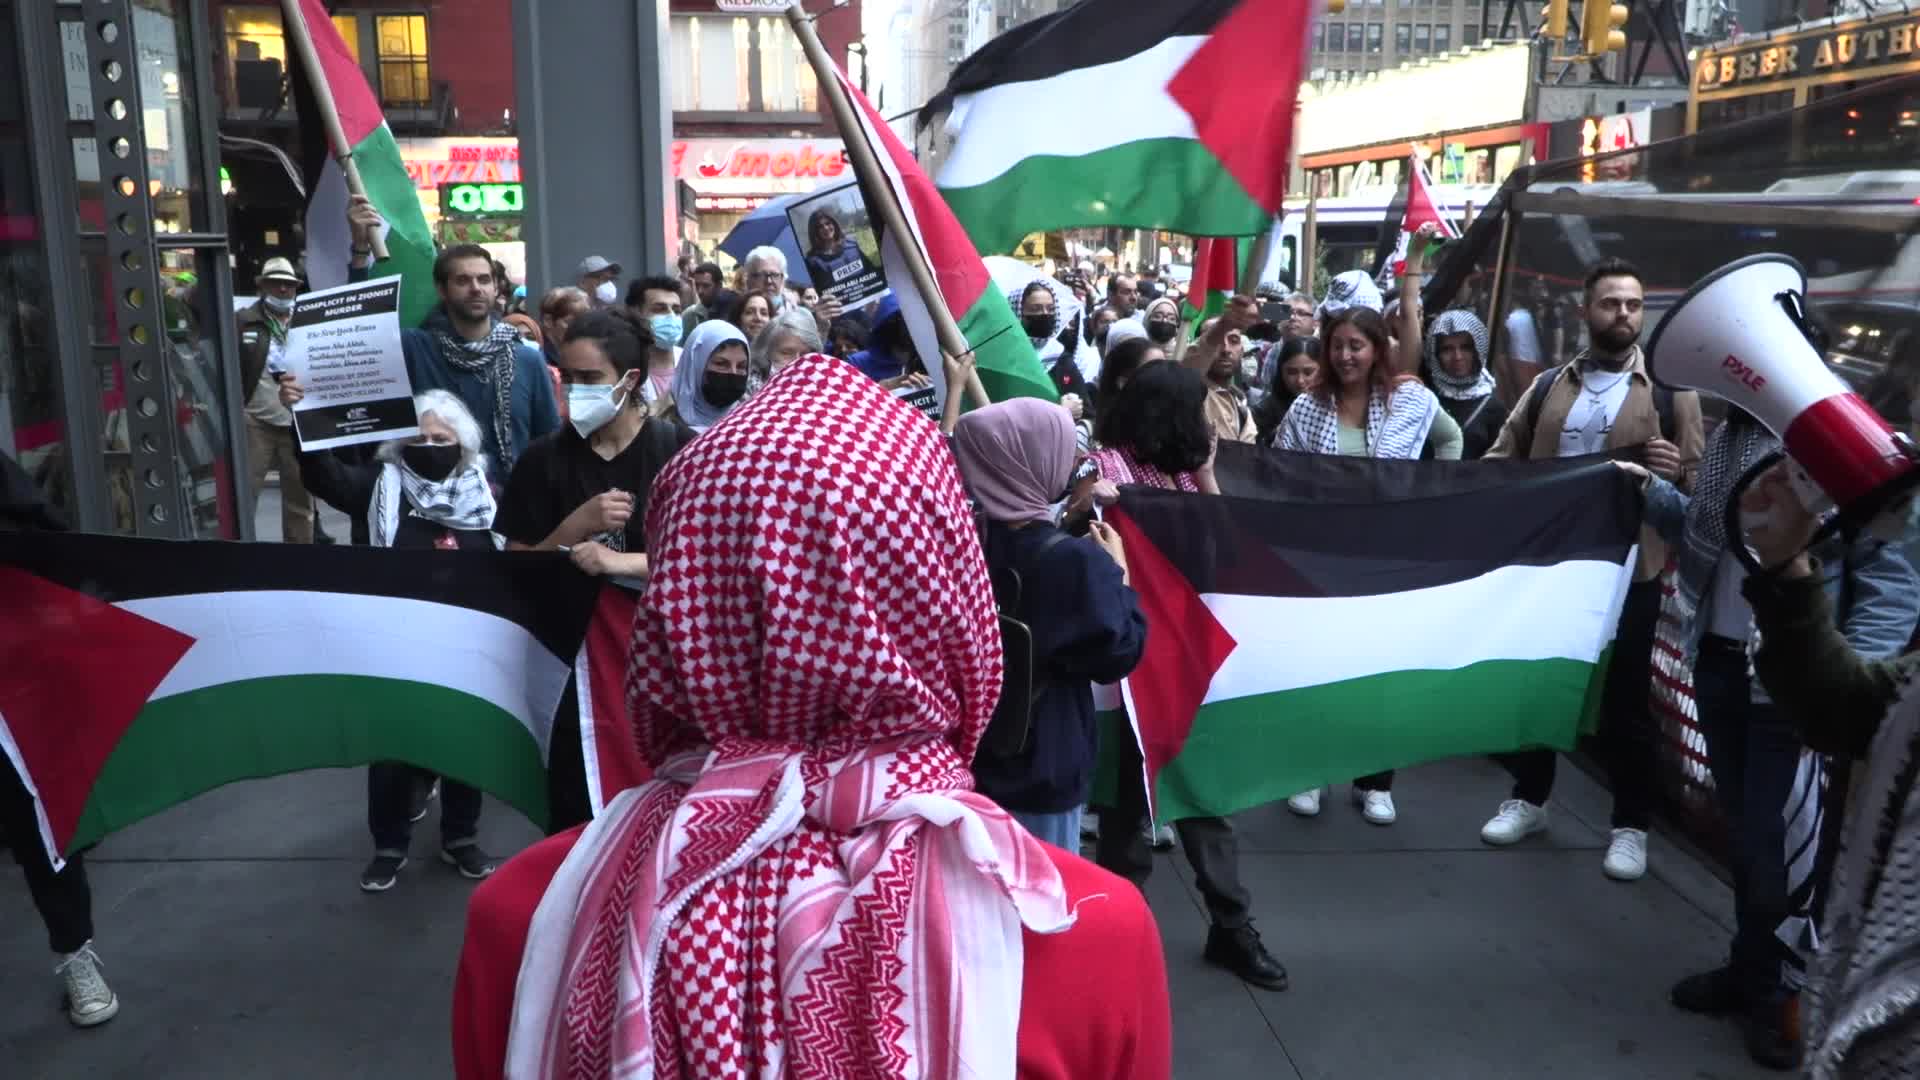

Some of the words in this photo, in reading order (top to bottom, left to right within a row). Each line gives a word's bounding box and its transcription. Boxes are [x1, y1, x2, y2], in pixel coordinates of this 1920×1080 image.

[1719, 45, 1800, 83] BEER
[405, 160, 502, 189] PIZZA
[837, 262, 861, 277] PRESS
[297, 297, 345, 312] COMPLICIT
[346, 294, 357, 303] IN
[358, 287, 394, 301] ZIONIST
[324, 303, 362, 317] MURDER
[1721, 353, 1766, 391] PYLE
